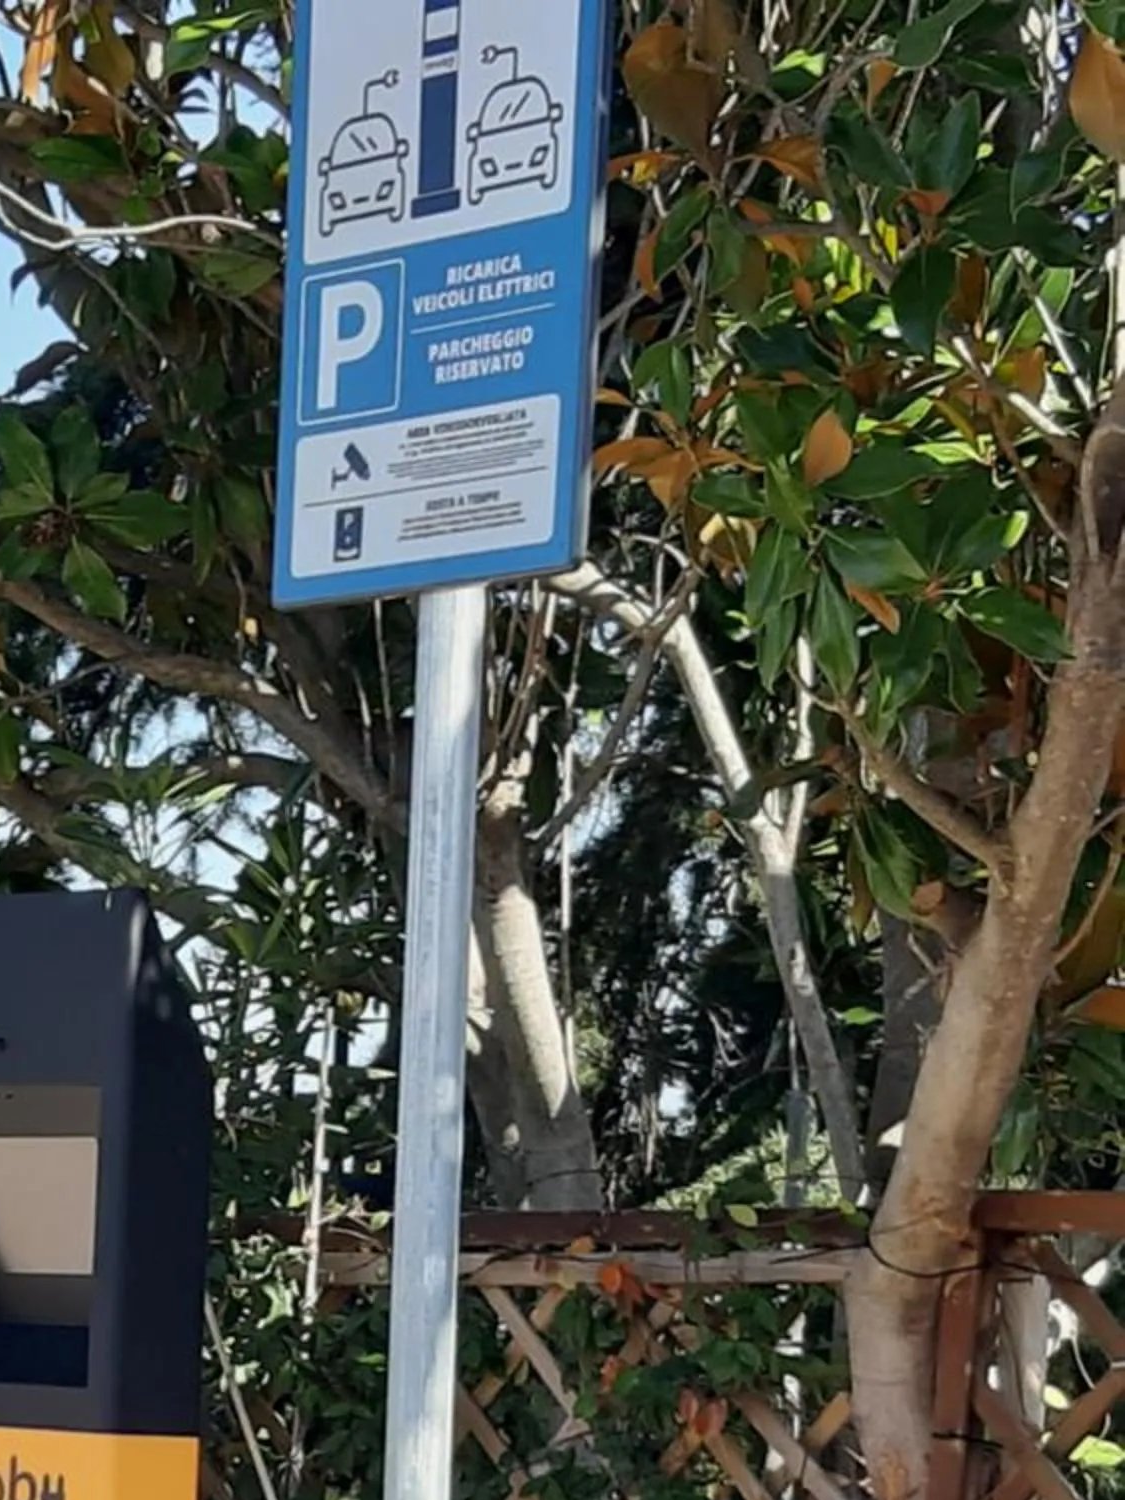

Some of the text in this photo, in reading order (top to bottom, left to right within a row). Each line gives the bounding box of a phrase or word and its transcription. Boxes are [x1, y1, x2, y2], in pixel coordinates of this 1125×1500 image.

[446, 254, 522, 285] RICARICA
[412, 270, 555, 316] VEICOLI ELETTRICI
[317, 280, 383, 411] P
[428, 325, 534, 362] PARCHEGGIO
[435, 351, 524, 385] RISERVATO
